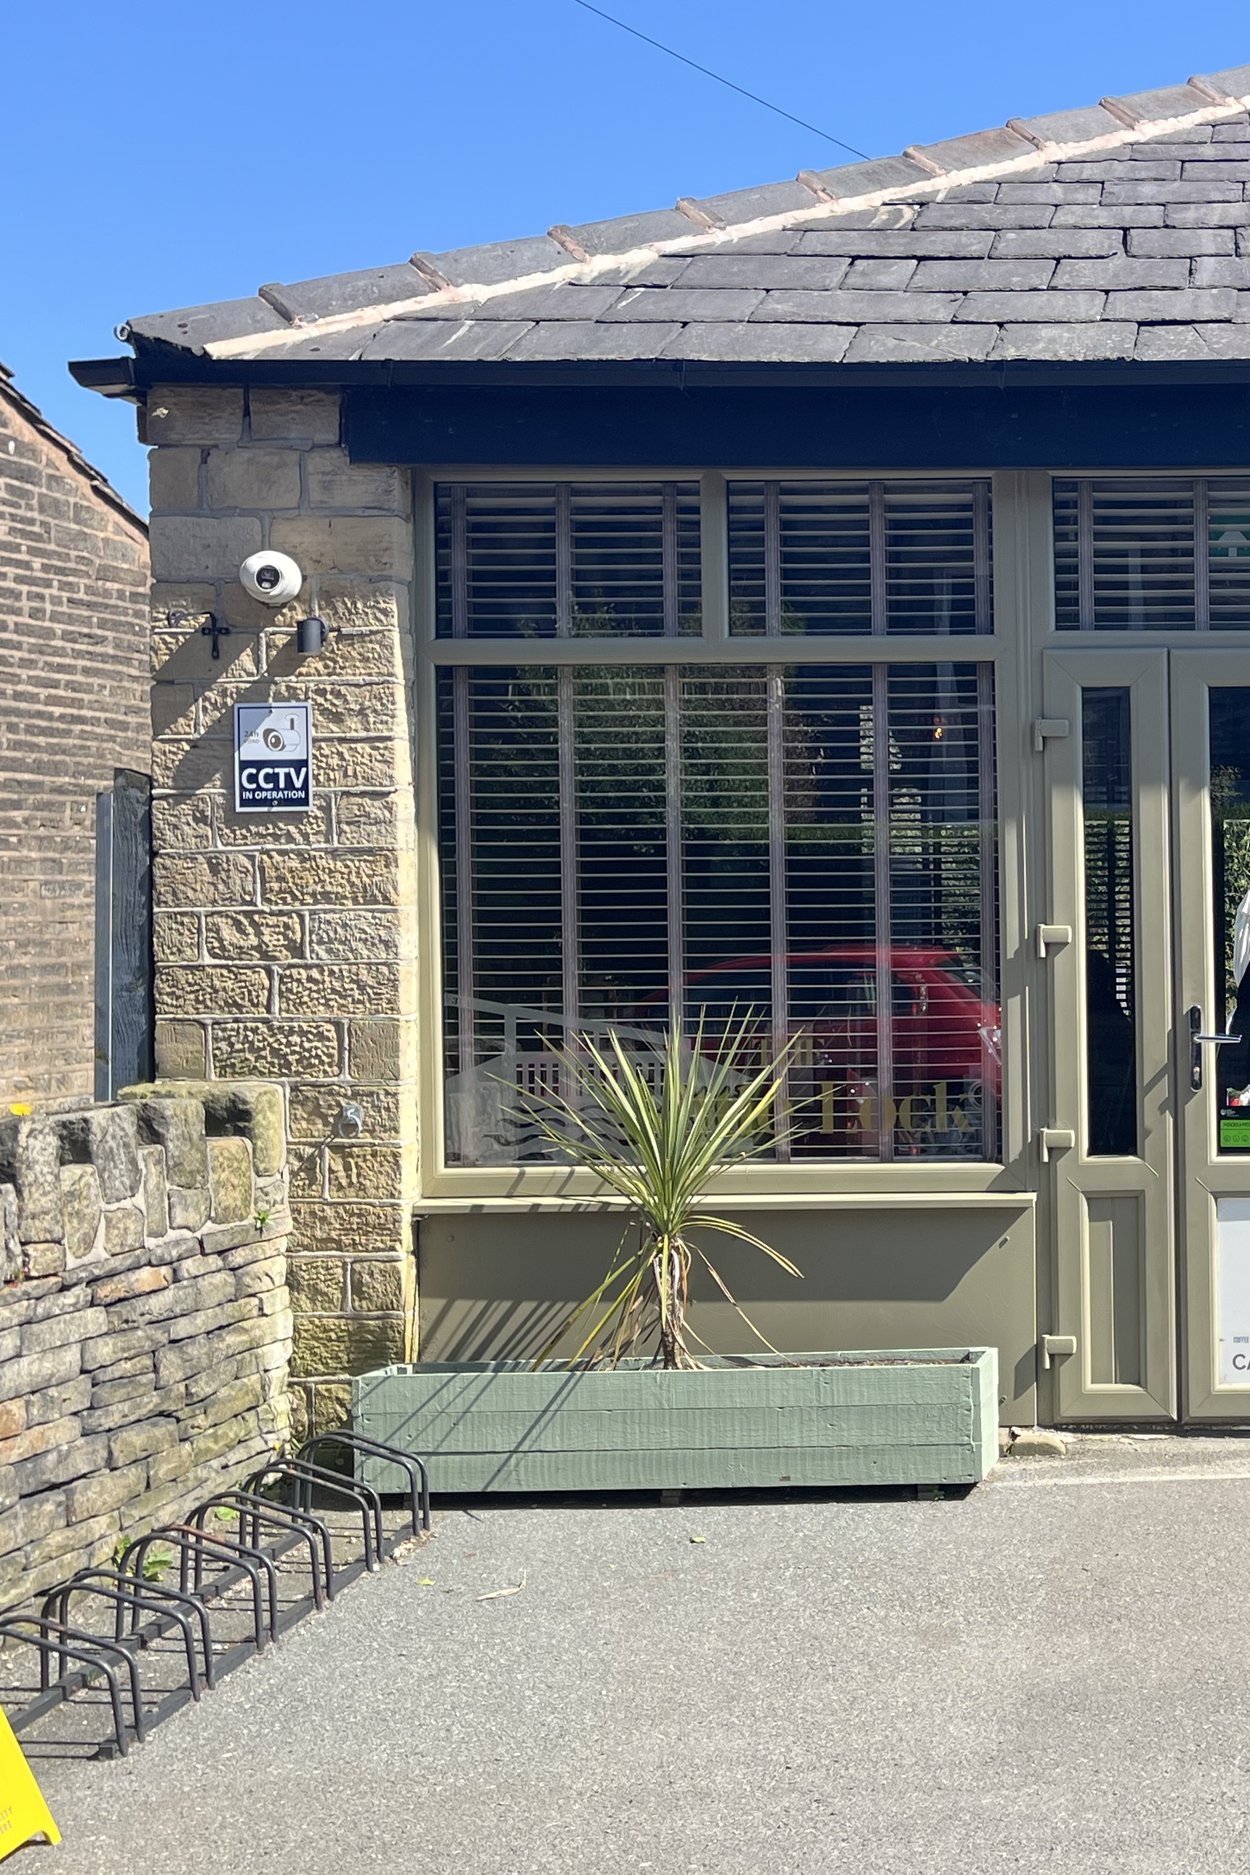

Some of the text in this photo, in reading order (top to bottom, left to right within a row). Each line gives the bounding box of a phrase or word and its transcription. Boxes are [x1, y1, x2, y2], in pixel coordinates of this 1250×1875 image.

[241, 767, 308, 789] CCTV
[242, 790, 305, 800] IN OPERATION
[820, 1081, 975, 1135] Lock
